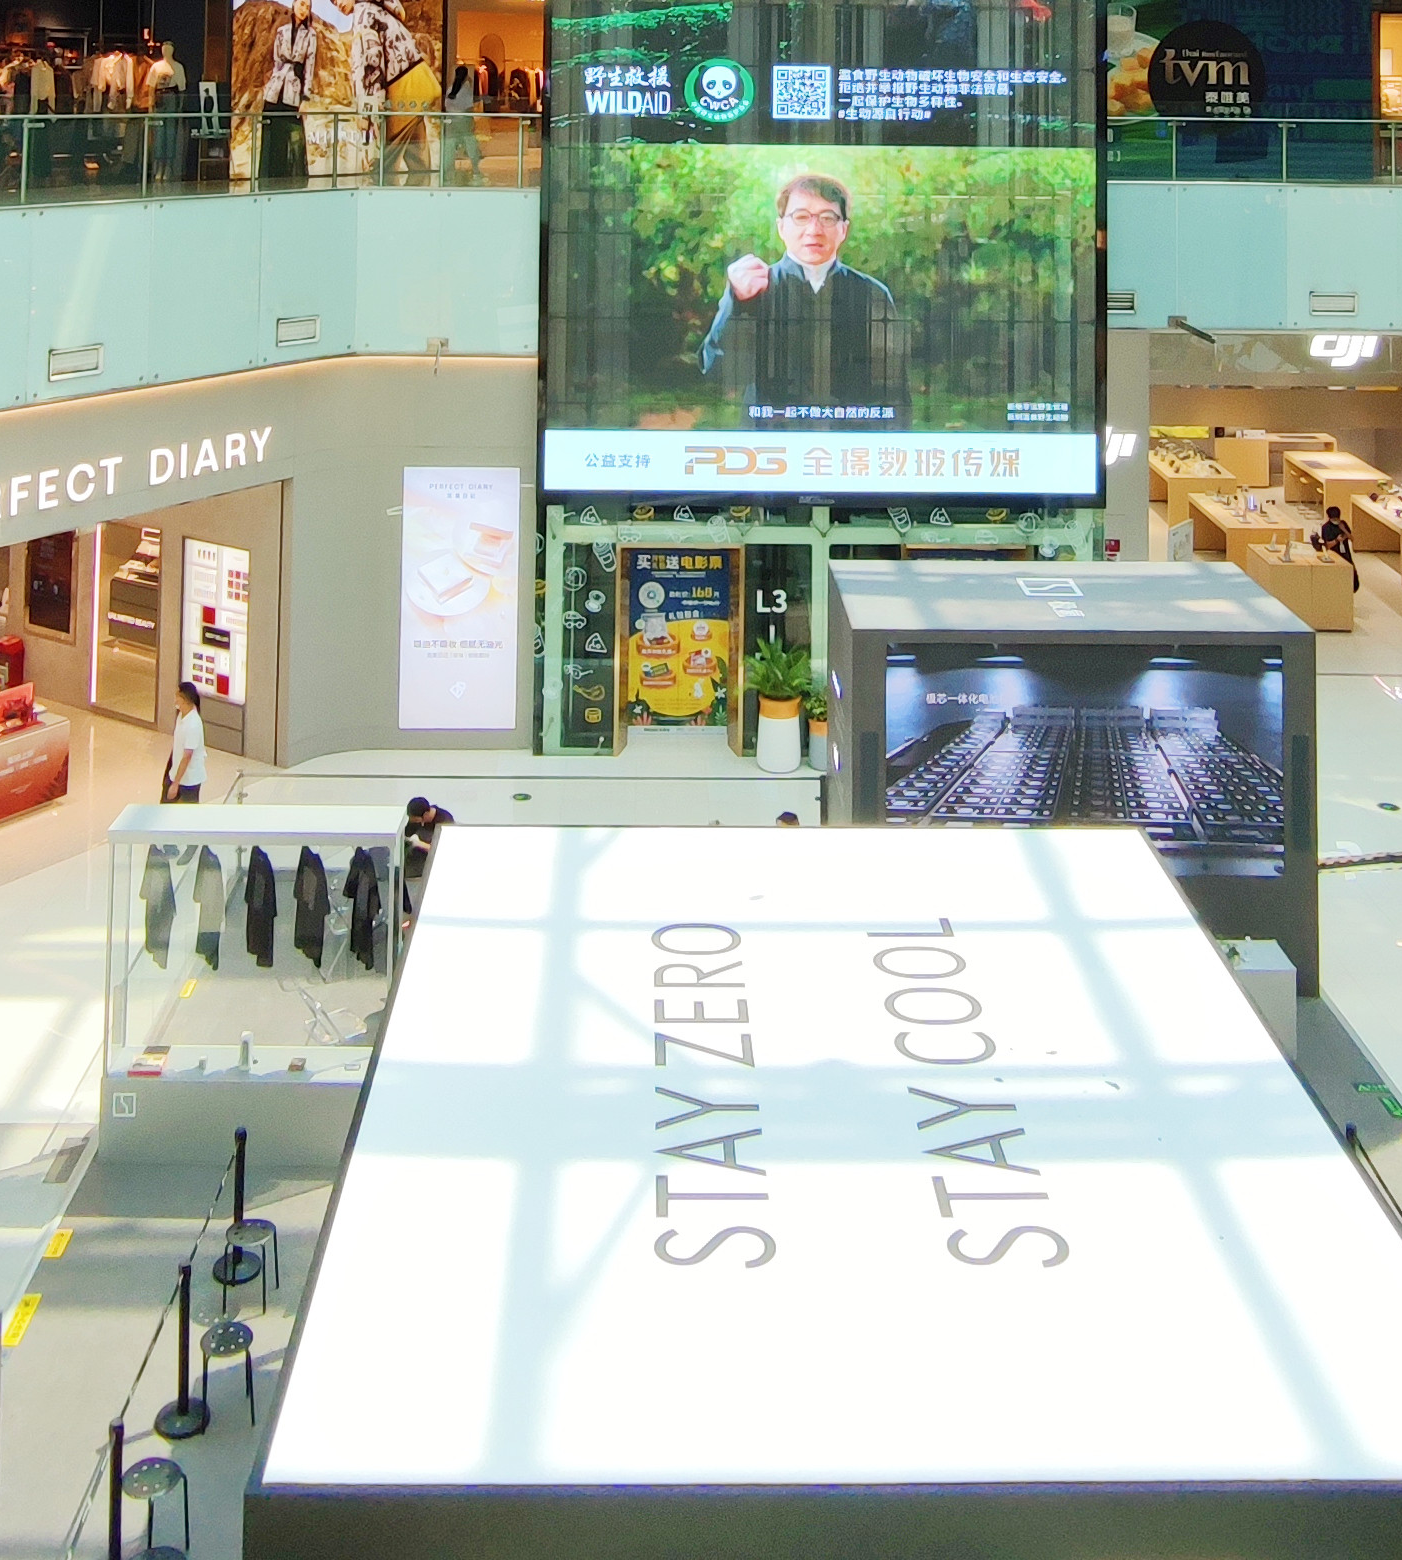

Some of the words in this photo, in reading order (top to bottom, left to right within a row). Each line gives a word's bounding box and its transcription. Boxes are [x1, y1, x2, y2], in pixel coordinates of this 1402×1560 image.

[584, 65, 672, 88] 野生救援
[1159, 49, 1250, 87] tvm
[585, 90, 672, 115] WILDAID
[700, 96, 739, 111] CWCA
[1310, 335, 1378, 367] DJI
[748, 406, 895, 419] 和我一起不做大自然的反派
[148, 426, 273, 486] DIARY
[585, 453, 652, 470] 公益支持
[756, 589, 788, 614] L3
[651, 922, 756, 1068] ZERO
[867, 917, 997, 1066] COOL
[654, 1086, 777, 1269] STAY
[907, 1086, 1070, 1269] STAY
